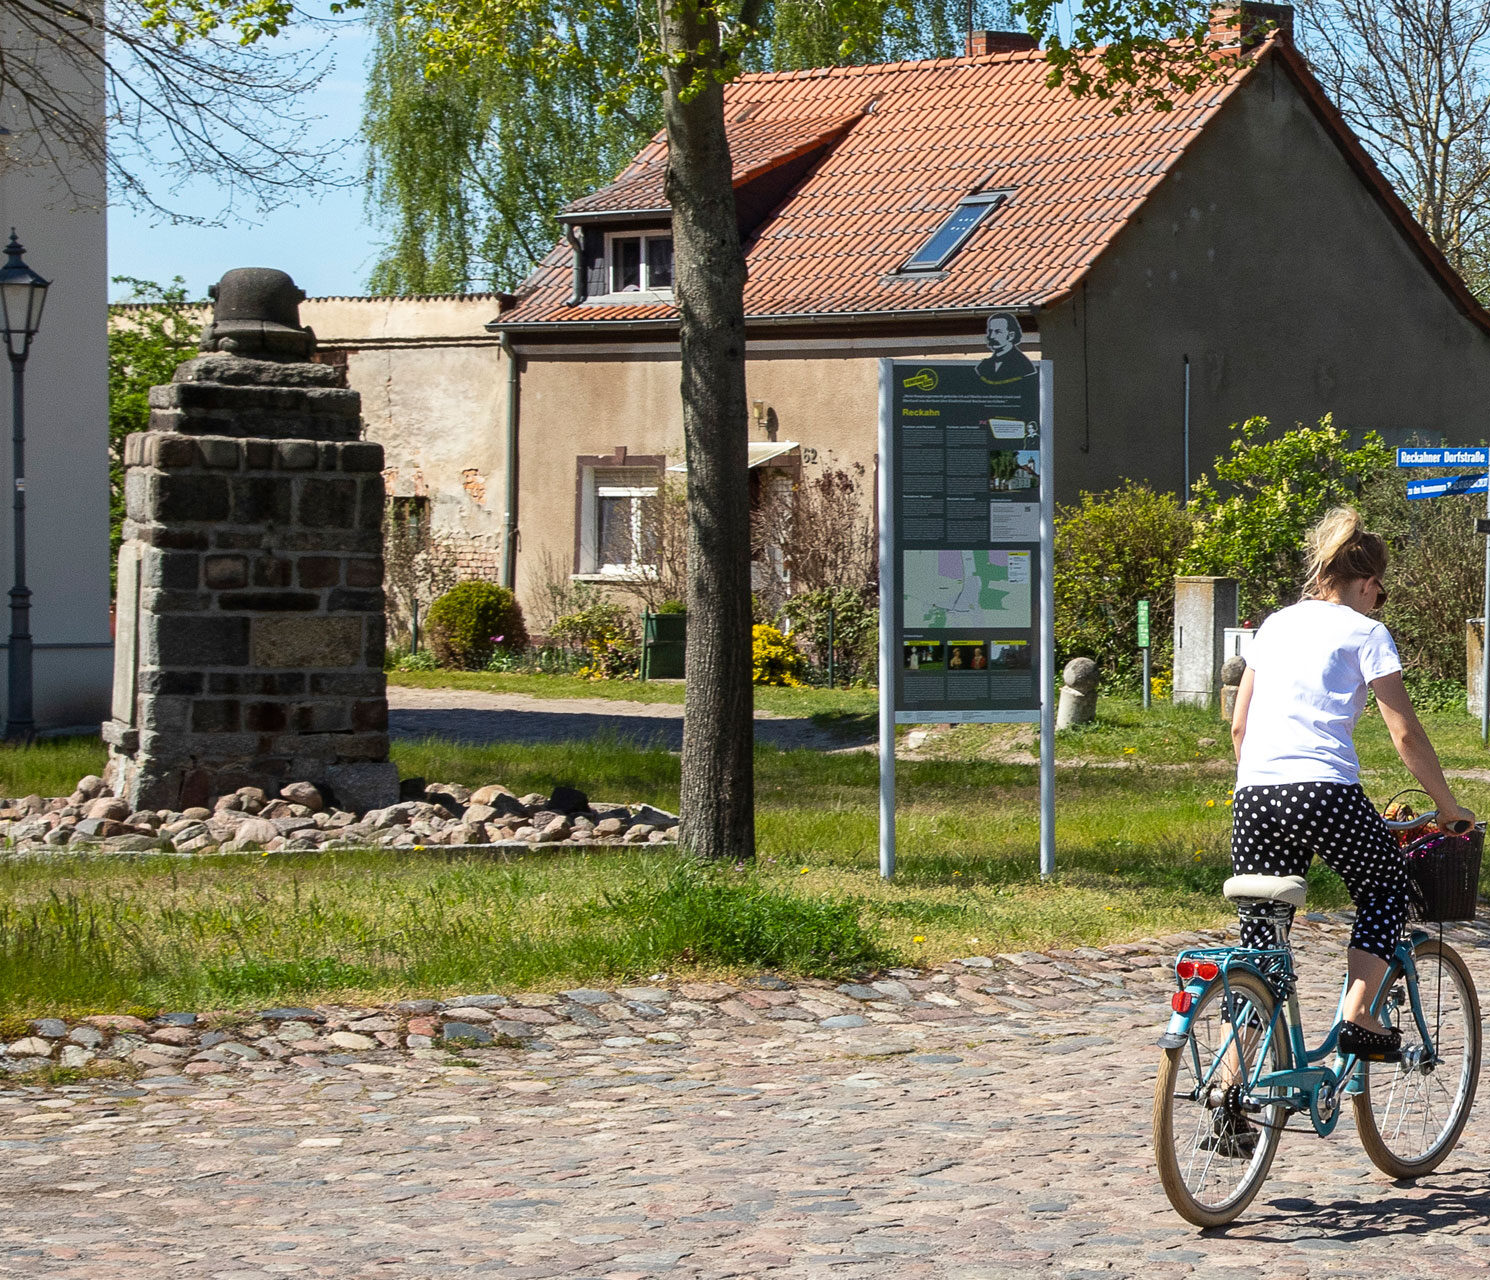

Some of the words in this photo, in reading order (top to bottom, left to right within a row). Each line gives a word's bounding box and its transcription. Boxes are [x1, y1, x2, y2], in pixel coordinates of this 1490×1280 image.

[902, 408, 940, 416] Reckahn
[1401, 451, 1441, 463] Reckahner
[1444, 451, 1486, 463] Dorfstraße
